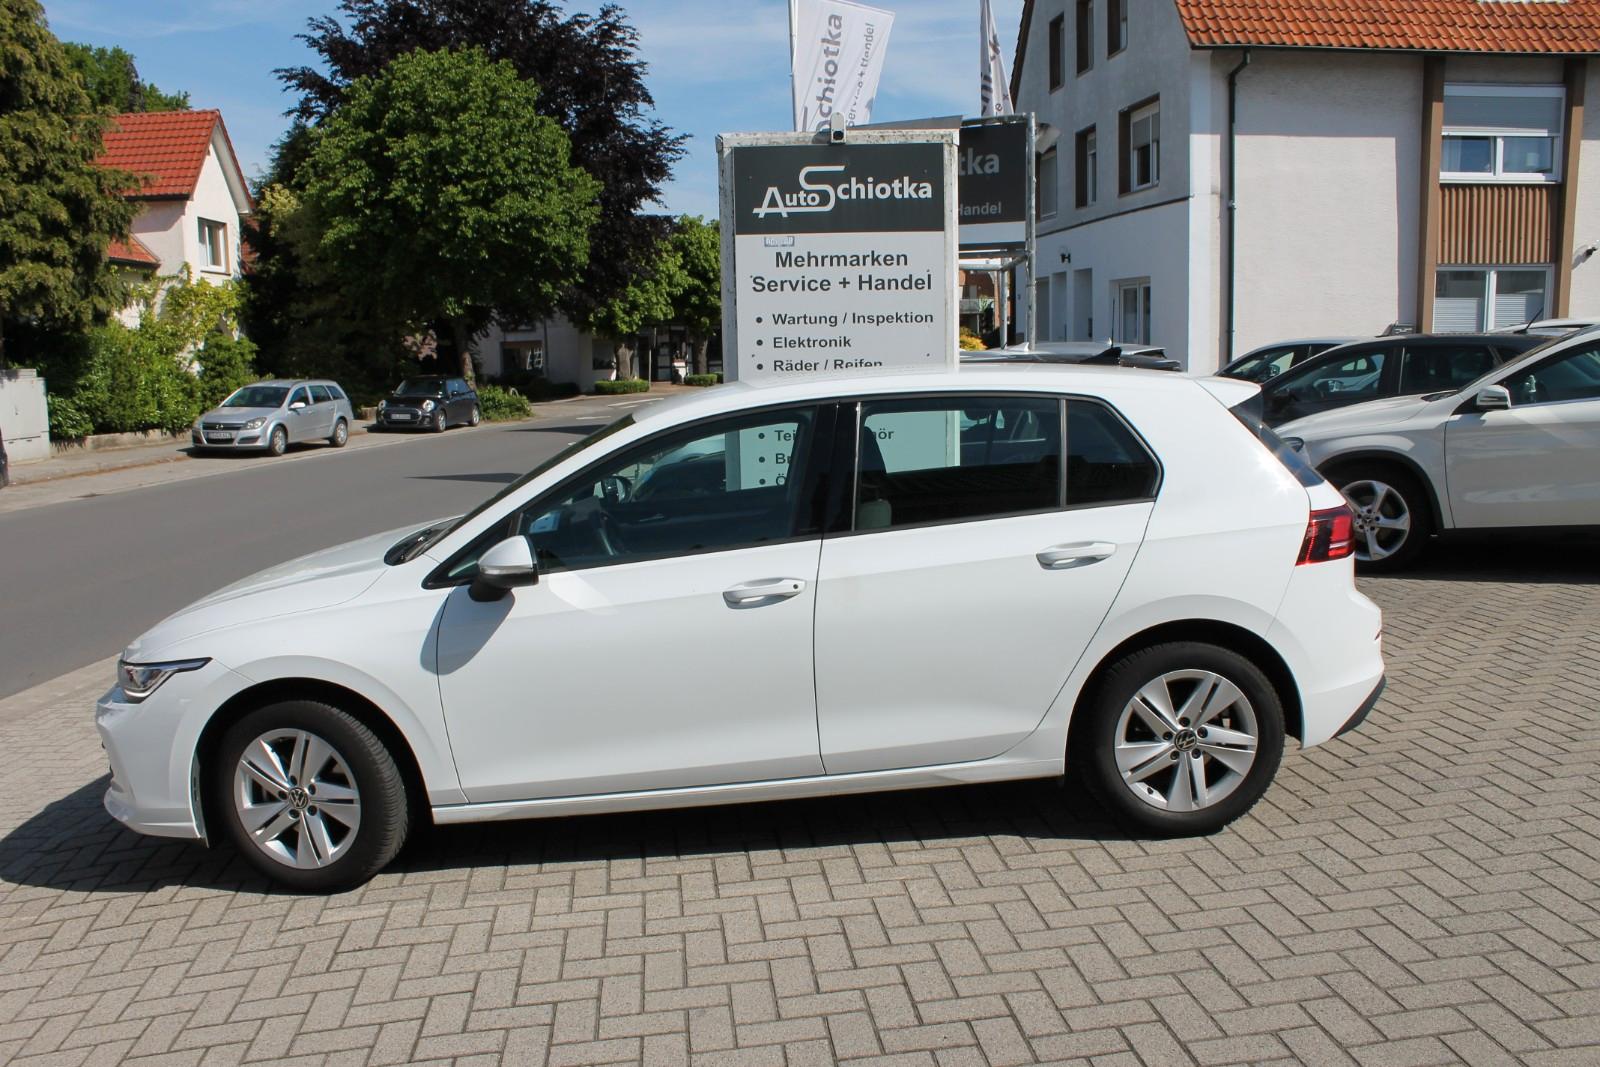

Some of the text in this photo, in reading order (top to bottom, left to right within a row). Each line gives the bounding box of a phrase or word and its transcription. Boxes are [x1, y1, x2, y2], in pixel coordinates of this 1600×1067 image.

[752, 165, 933, 218] Auto Schiotka
[775, 250, 908, 268] Mehrmarken
[752, 273, 932, 293] Service + Handel
[772, 313, 838, 327] Wartung
[852, 312, 934, 326] Inspektion
[773, 336, 852, 349] Elektronik
[773, 360, 820, 372] Räder
